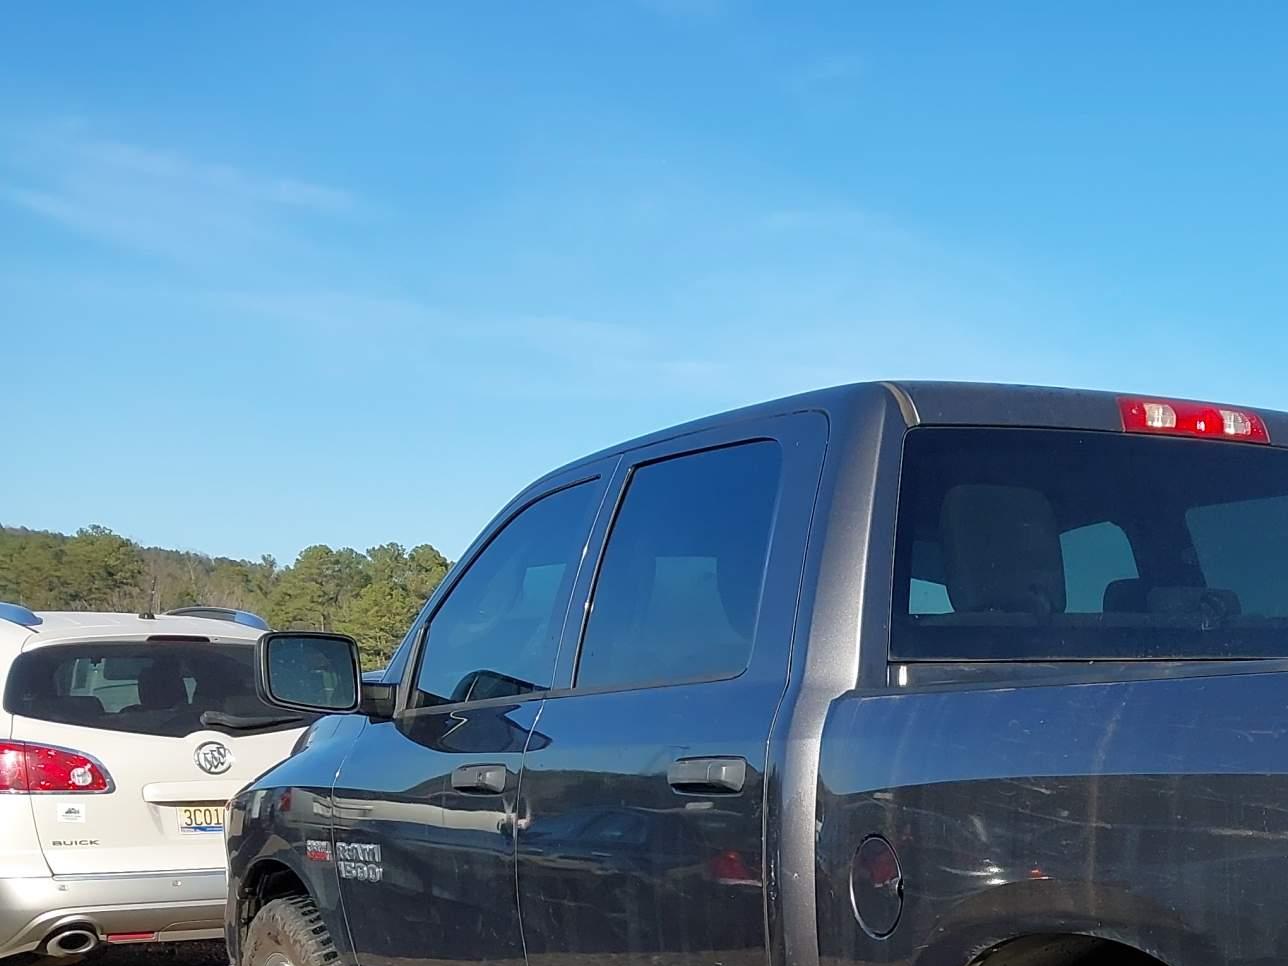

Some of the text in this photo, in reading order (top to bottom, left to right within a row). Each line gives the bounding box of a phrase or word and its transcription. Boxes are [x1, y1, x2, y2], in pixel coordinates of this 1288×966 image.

[183, 808, 223, 826] 3C01
[335, 841, 382, 862] RAM
[337, 861, 383, 883] 1500
